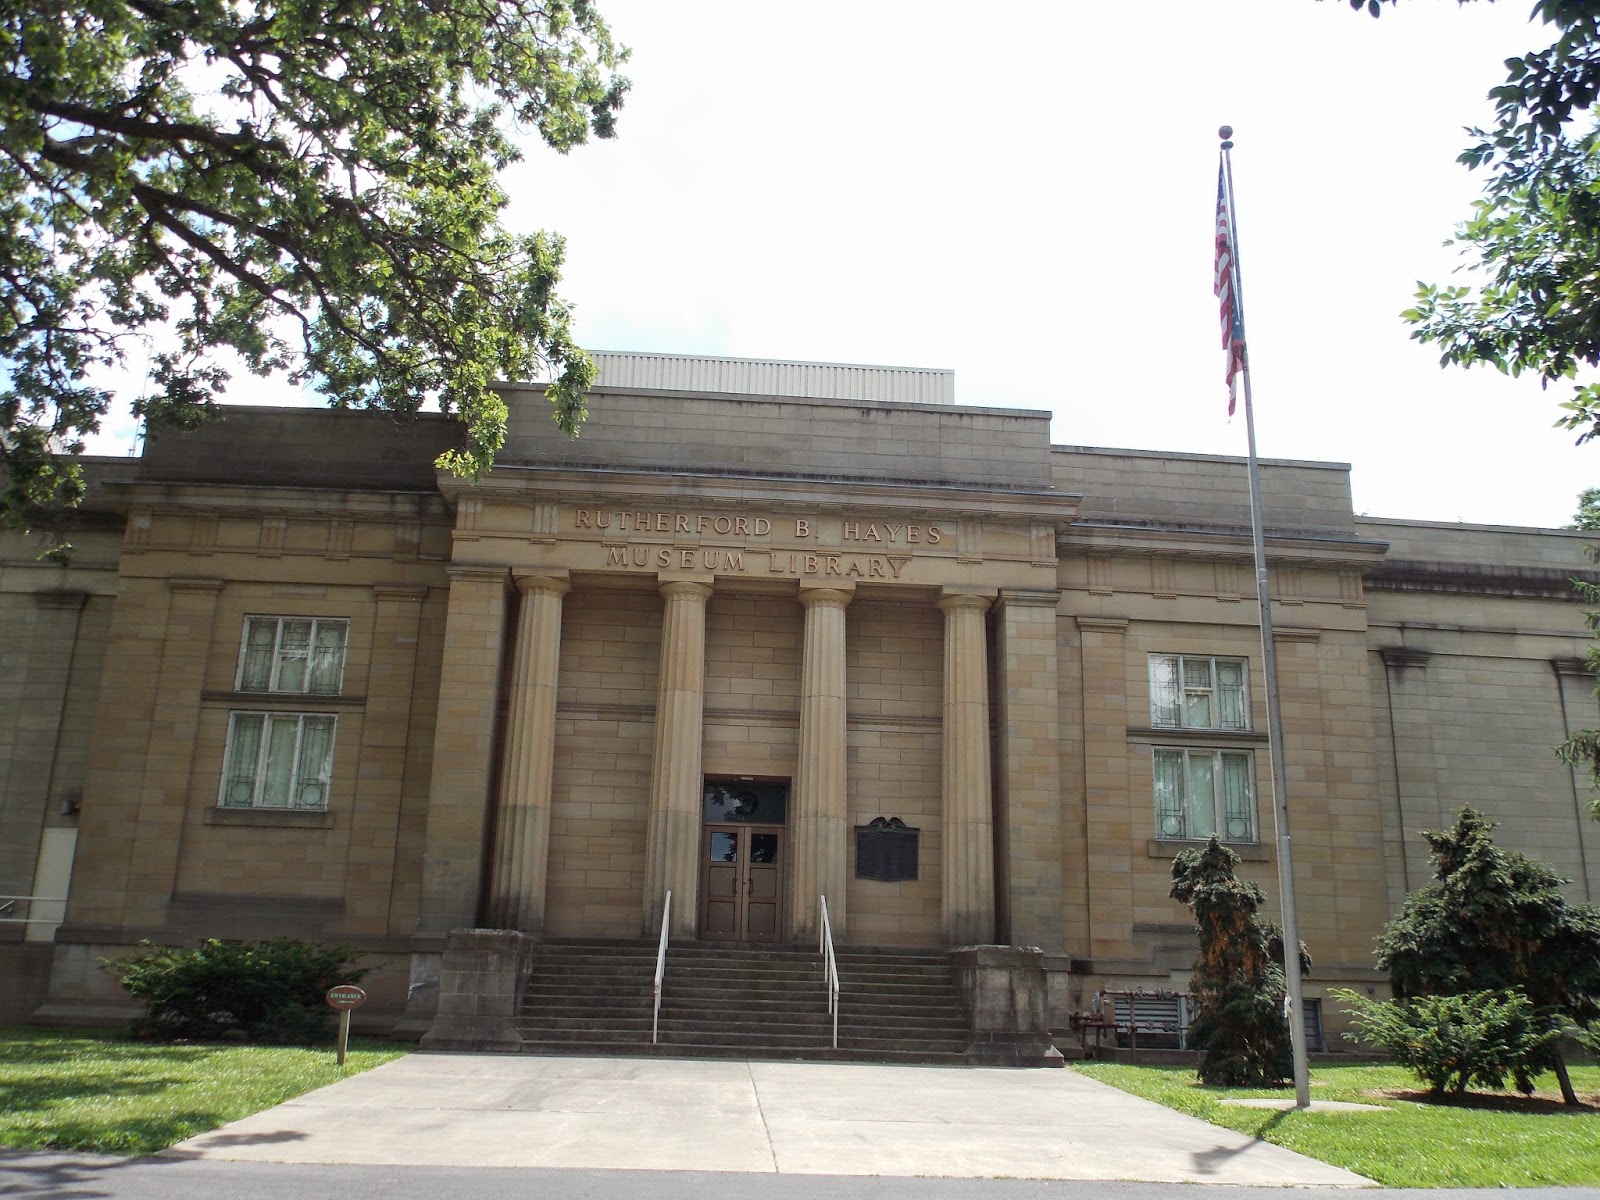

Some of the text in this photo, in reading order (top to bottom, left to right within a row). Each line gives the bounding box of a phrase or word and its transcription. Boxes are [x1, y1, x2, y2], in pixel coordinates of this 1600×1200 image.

[575, 509, 772, 536] RUTHERFORD
[843, 521, 941, 544] HAYES
[606, 548, 907, 578] MUSEUM LIBRARY
